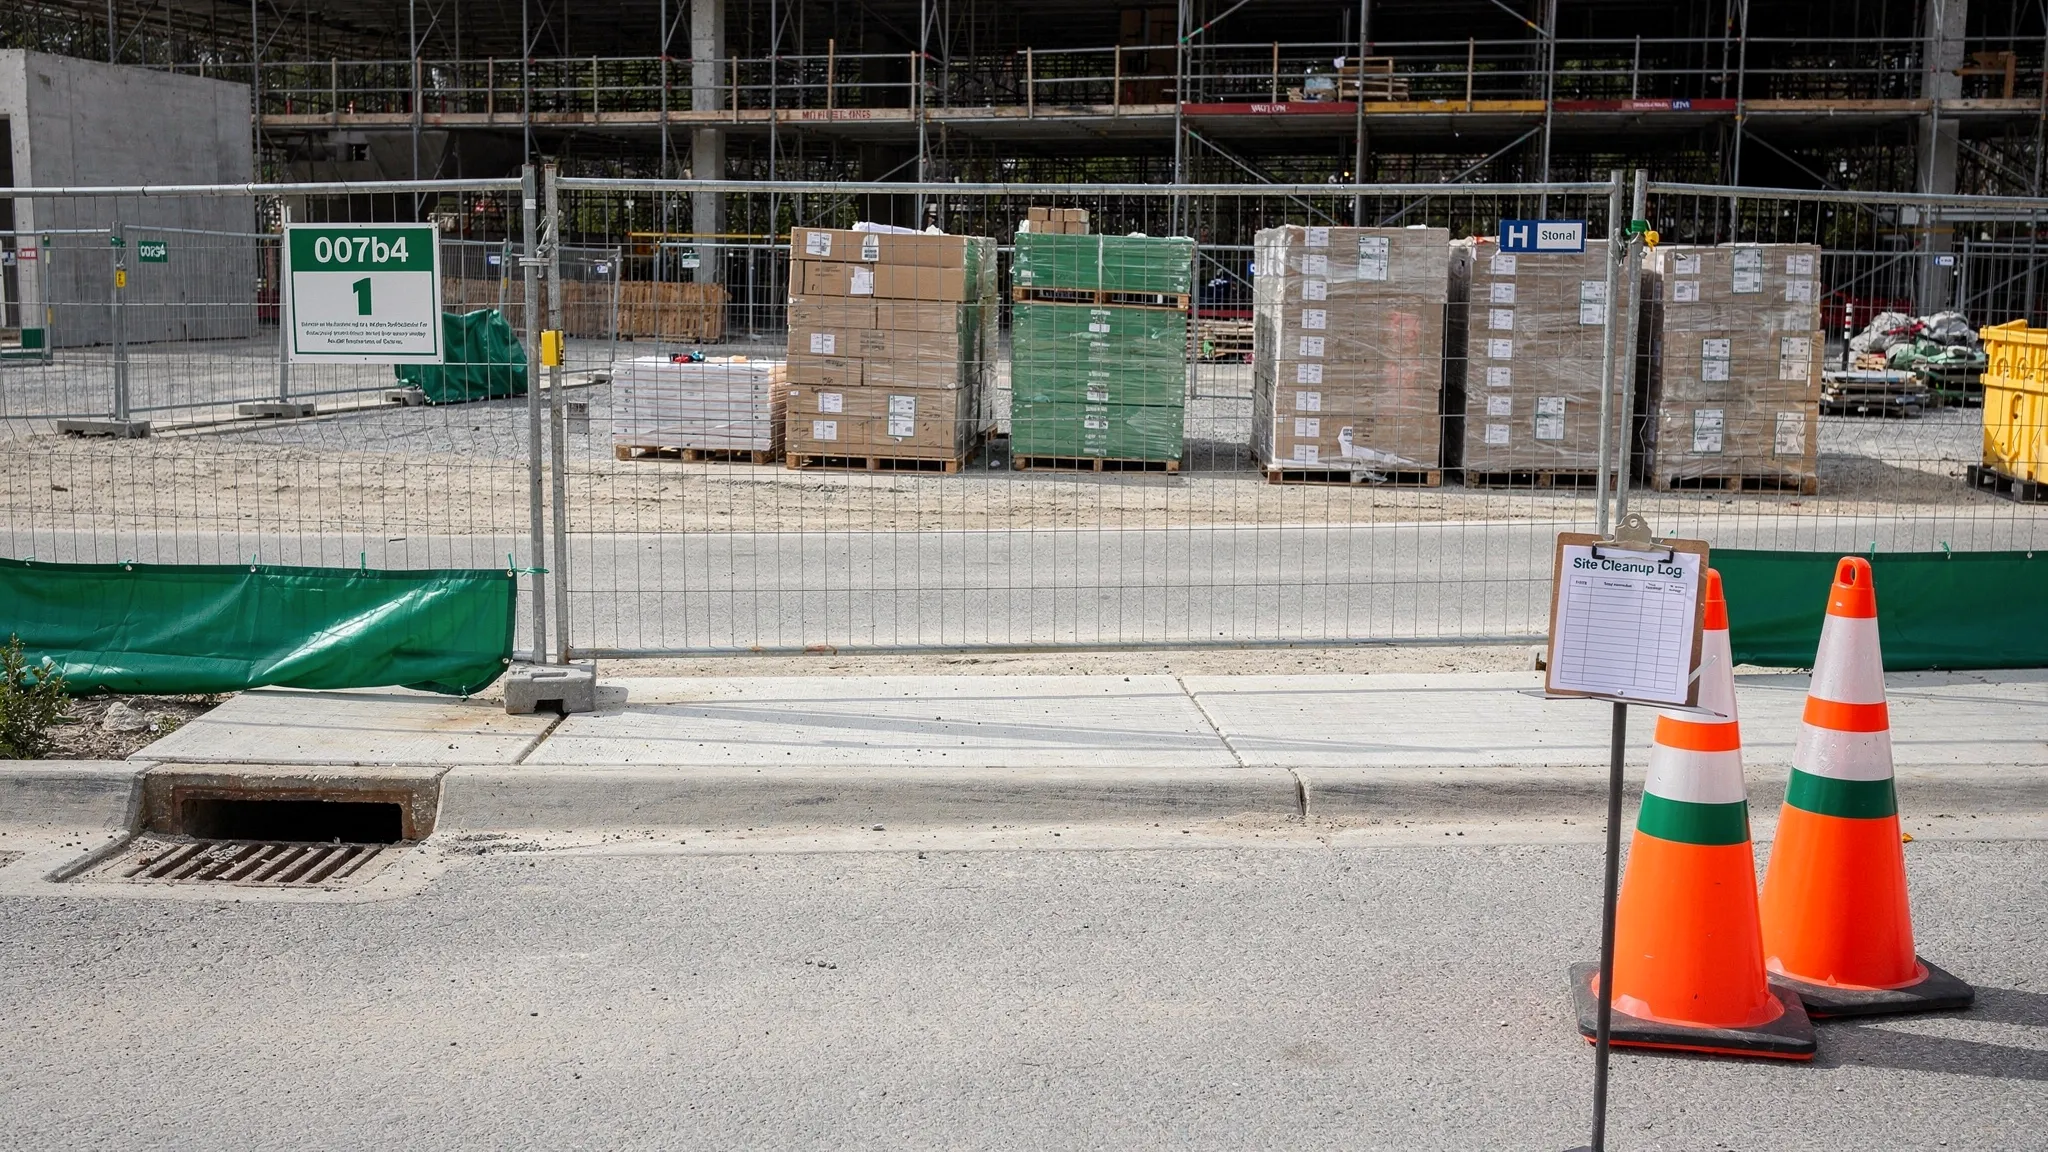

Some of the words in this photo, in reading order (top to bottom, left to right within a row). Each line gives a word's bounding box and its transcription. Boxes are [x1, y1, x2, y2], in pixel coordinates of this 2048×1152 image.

[1508, 225, 1529, 248] H
[1541, 230, 1576, 241] Stonal
[314, 236, 409, 263] 007b4
[352, 277, 372, 316] 1
[1573, 557, 1598, 570] Site
[1601, 559, 1655, 576] Cleanup
[1657, 562, 1683, 578] Log
